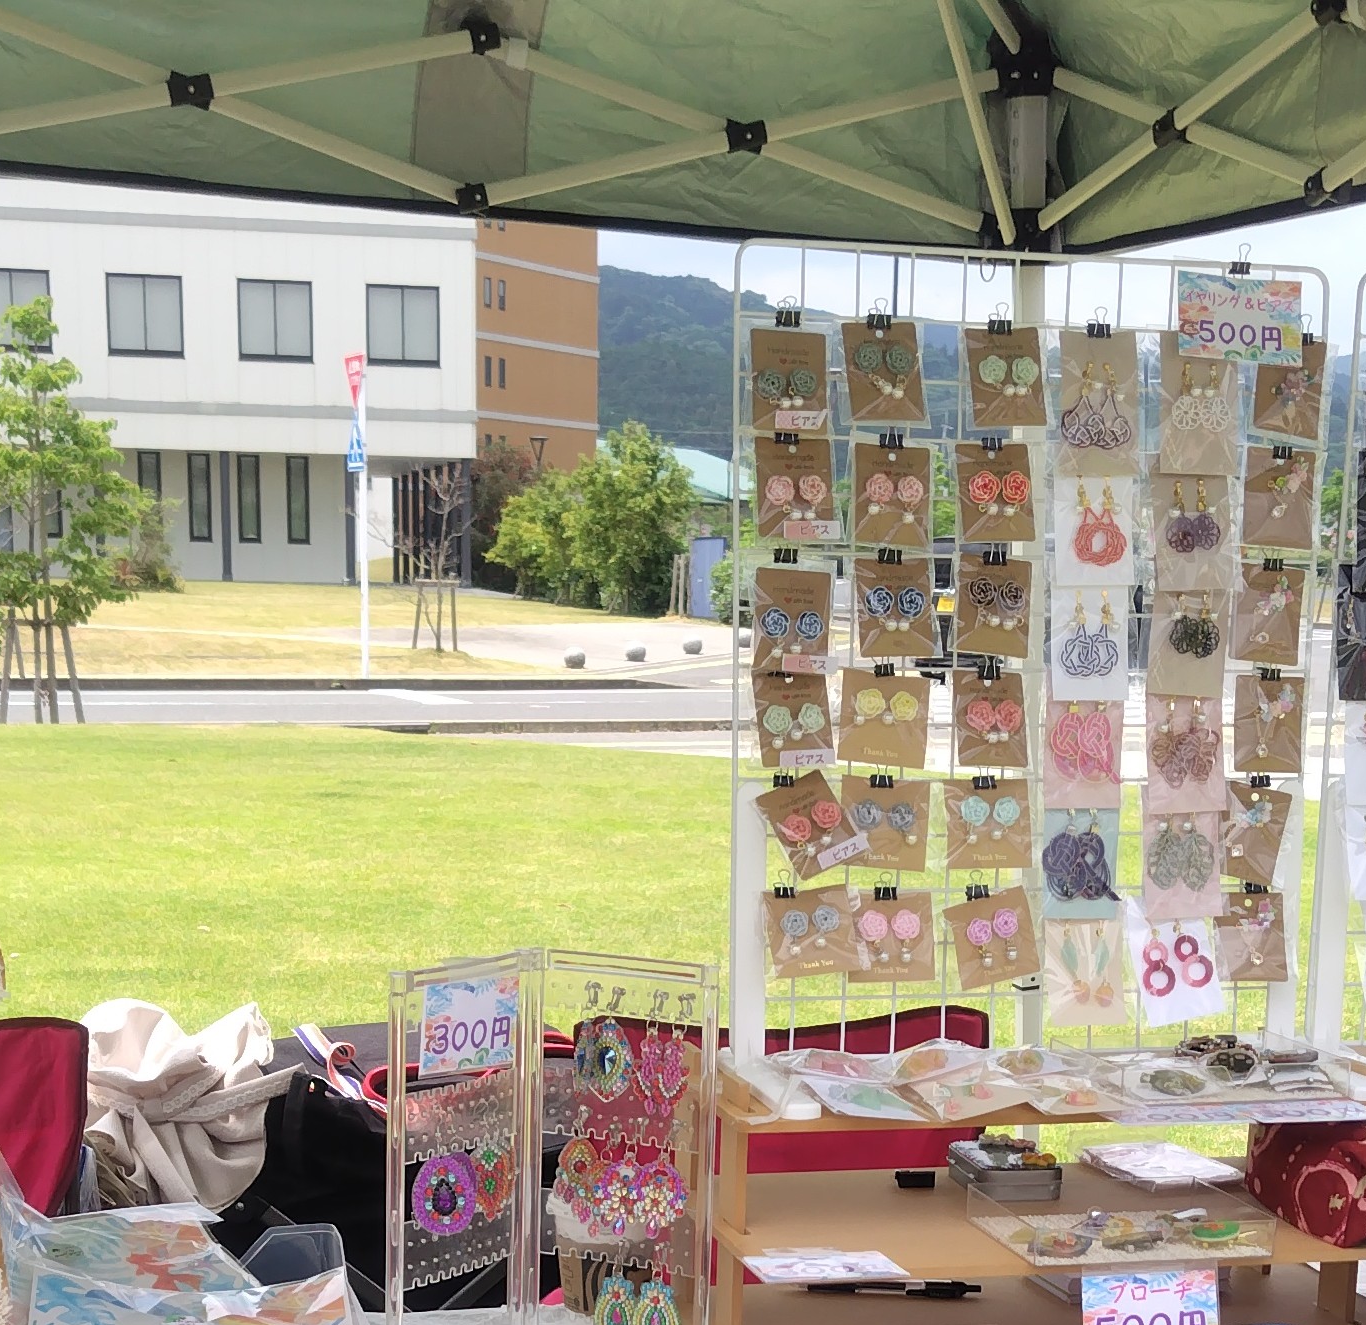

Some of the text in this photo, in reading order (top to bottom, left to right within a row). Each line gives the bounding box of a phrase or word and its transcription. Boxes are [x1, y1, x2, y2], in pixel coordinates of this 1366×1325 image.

[1199, 320, 1282, 351] 500円
[800, 523, 829, 535] ピアス
[799, 658, 826, 670] ピアス
[864, 747, 898, 758] Thank You
[795, 754, 825, 765] ピアス
[833, 842, 859, 860] ピアス
[887, 854, 899, 862] You
[798, 961, 819, 969] Thank
[432, 1016, 510, 1054] 300円
[1109, 1280, 1194, 1303] ブローチ
